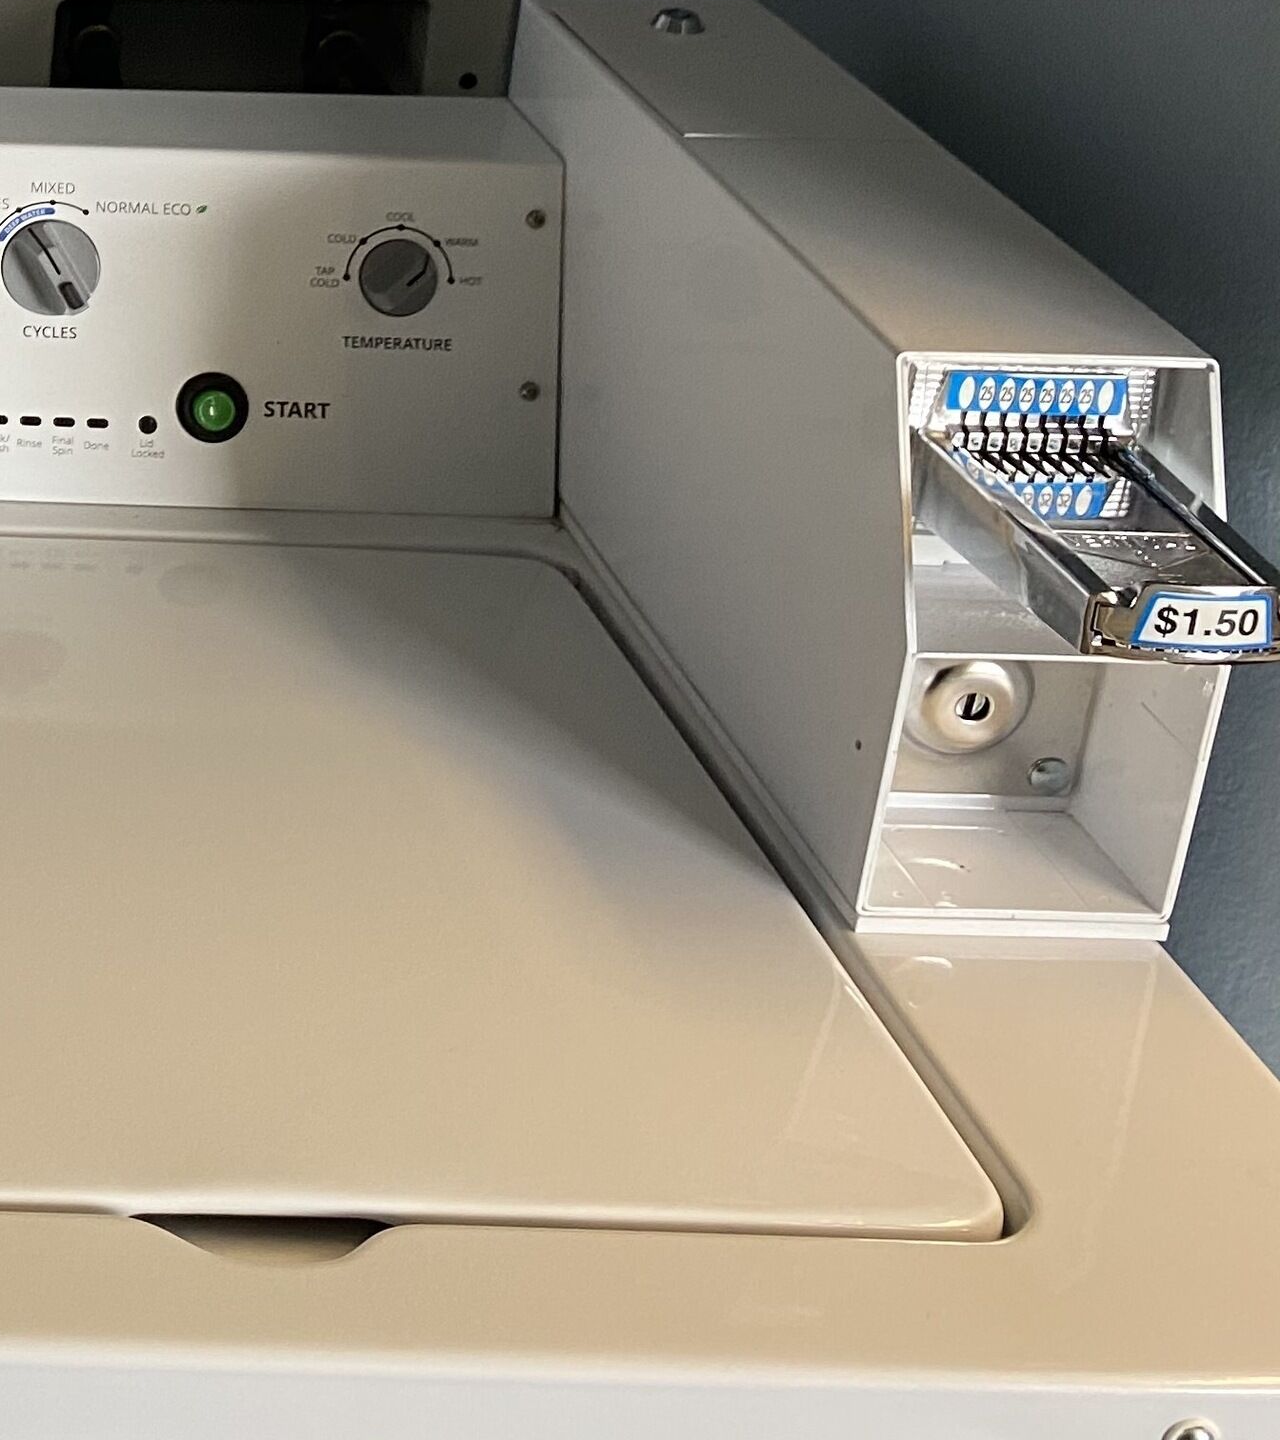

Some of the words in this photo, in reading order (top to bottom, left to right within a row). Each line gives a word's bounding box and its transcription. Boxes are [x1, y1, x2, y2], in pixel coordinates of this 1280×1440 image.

[30, 181, 75, 195] MIXED
[96, 201, 159, 215] NORMAL
[163, 202, 192, 216] ECO
[386, 212, 415, 222] COOL
[327, 233, 357, 244] COLD
[315, 266, 335, 275] TAP
[310, 278, 340, 288] COLD
[459, 277, 482, 286] HOT
[22, 325, 77, 340] CYCLES
[342, 336, 452, 351] TEMPERATURE
[980, 386, 993, 401] 25
[1000, 387, 1013, 401] 25
[1020, 387, 1034, 402] 25
[1040, 388, 1054, 403] 25
[1060, 389, 1073, 403] 25
[1079, 389, 1092, 404] 25
[264, 401, 330, 419] START
[17, 439, 42, 448] Rinse
[52, 436, 74, 445] Final
[83, 441, 110, 450] Done
[52, 446, 73, 456] Spin
[131, 449, 165, 459] Locked
[1154, 605, 1260, 636] $1.50
